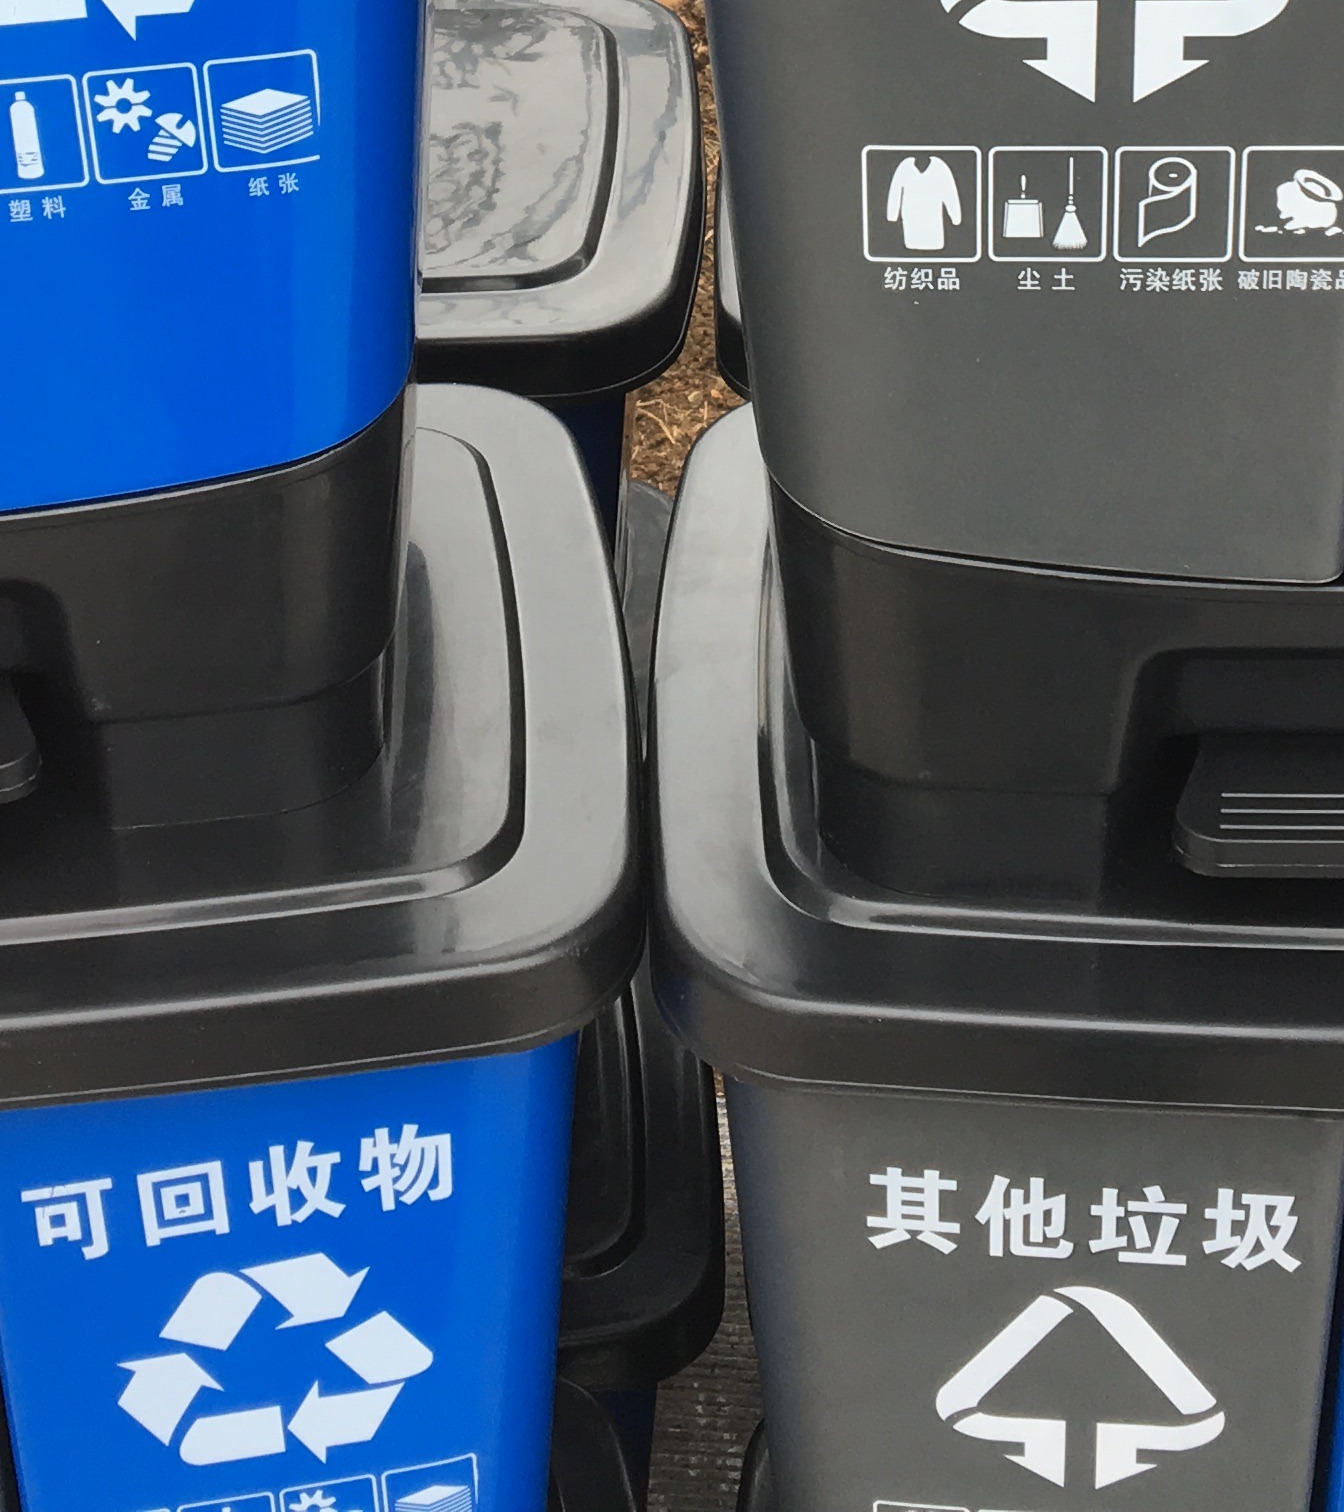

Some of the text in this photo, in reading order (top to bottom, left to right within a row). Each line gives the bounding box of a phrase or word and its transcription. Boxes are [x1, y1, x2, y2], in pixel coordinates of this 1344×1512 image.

[8, 195, 67, 223] 塑料
[128, 183, 184, 211] 金属
[248, 172, 300, 197] 纸张
[883, 266, 960, 291] 纺织品
[1017, 267, 1076, 291] 尘土
[1119, 267, 1224, 292] 污染纸张
[20, 1123, 453, 1260] 可回收物
[866, 1166, 1302, 1273] 其他垃圾
